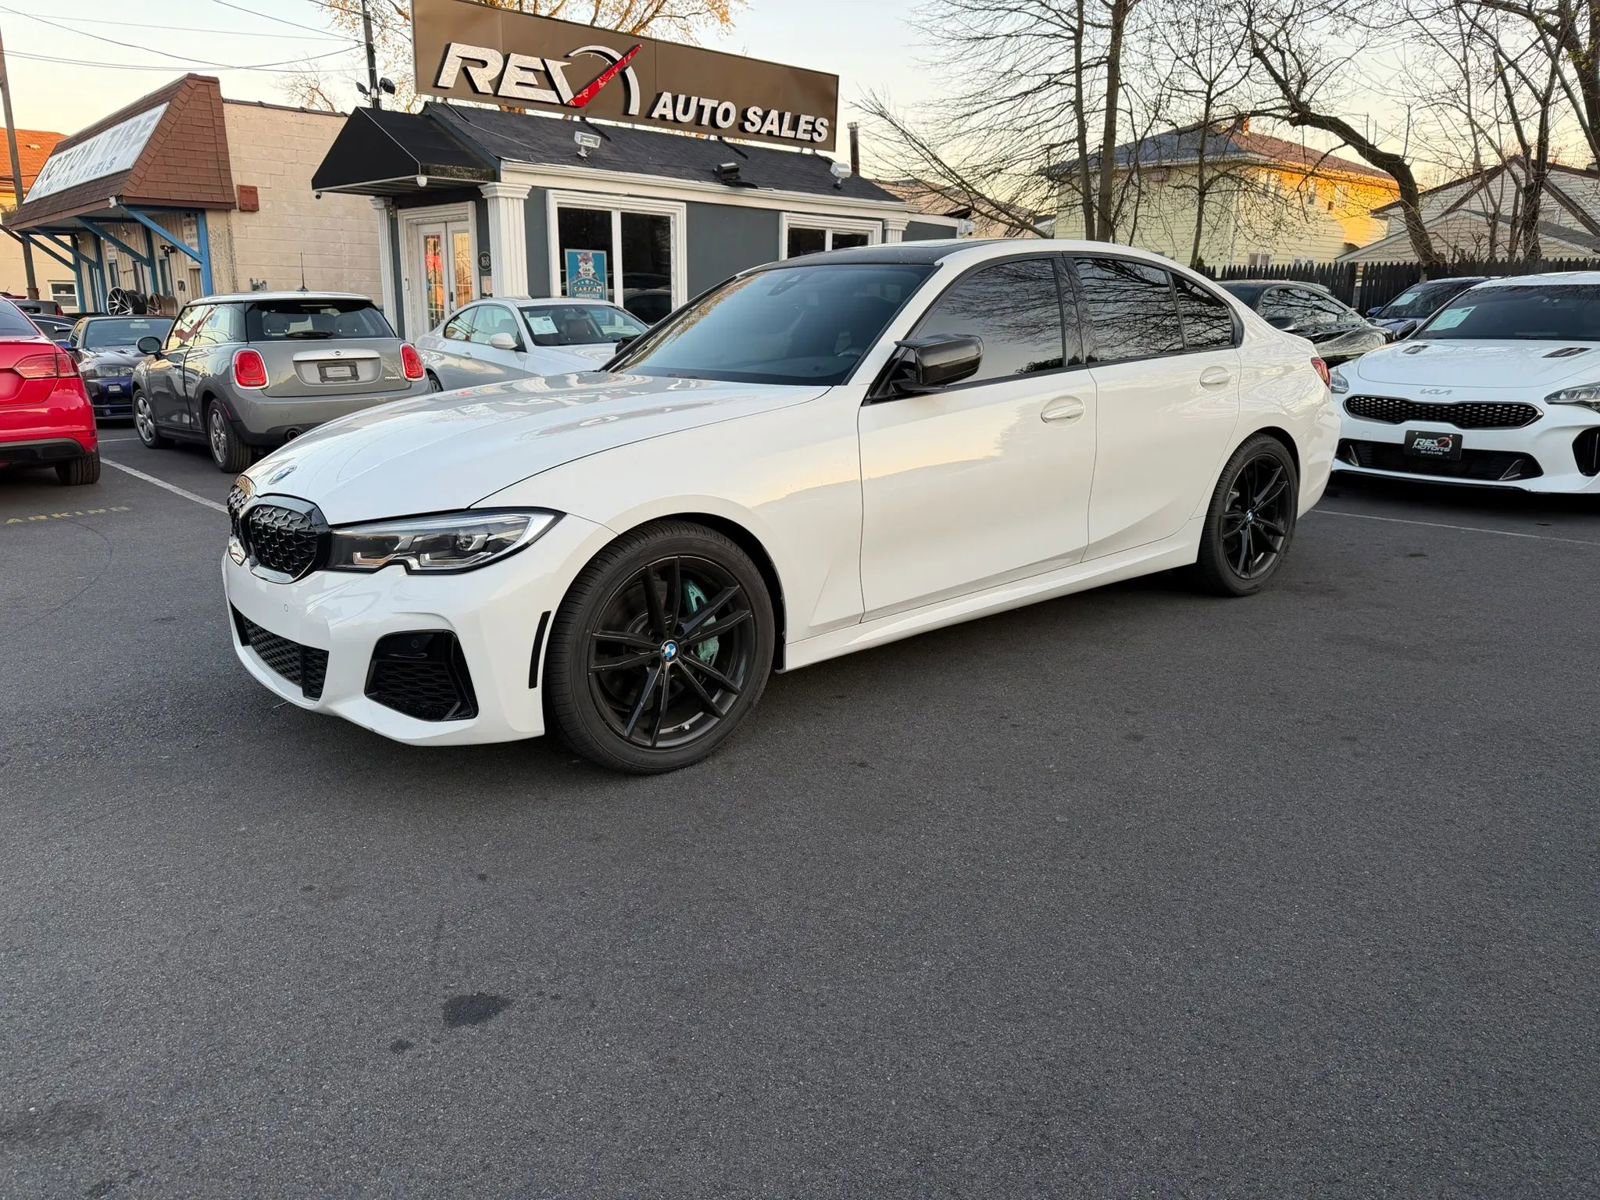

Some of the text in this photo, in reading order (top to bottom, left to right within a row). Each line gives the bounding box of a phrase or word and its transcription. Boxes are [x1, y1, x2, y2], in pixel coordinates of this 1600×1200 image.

[437, 42, 642, 109] REV
[35, 111, 160, 184] ACTION TIRE
[651, 91, 830, 143] AUTO SALES
